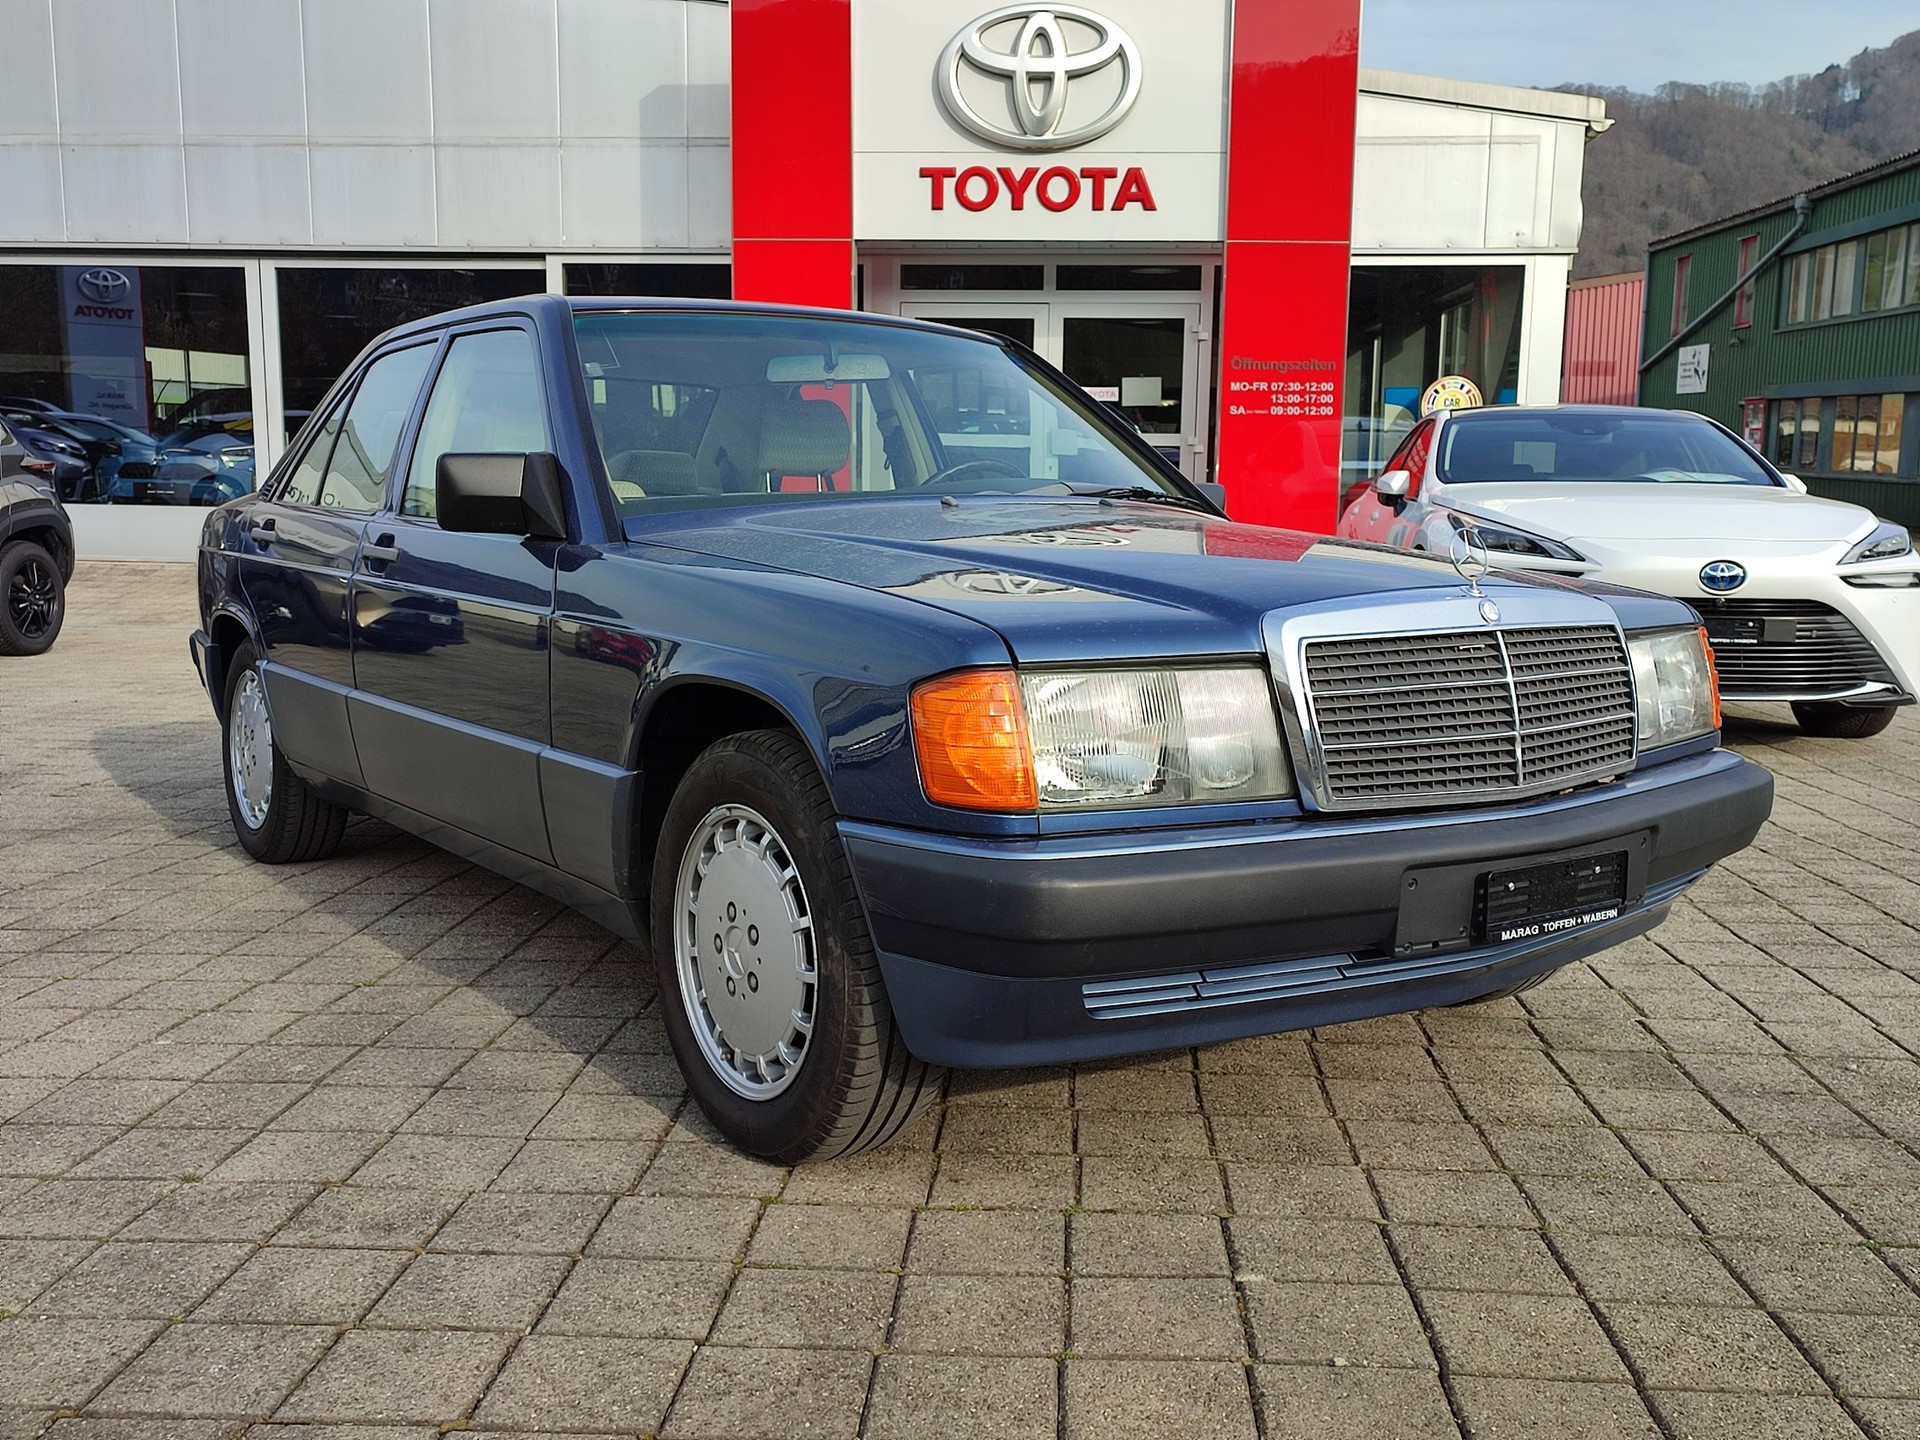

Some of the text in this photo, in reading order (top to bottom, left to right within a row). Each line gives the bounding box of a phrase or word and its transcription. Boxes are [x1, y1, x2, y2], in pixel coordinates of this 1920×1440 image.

[919, 165, 1157, 212] TOYOTA
[1230, 356, 1336, 373] Öffnungszeiten
[1230, 382, 1334, 392] MO-FR 07:30-12:00
[1270, 394, 1333, 404] 13:00-17:00
[1443, 397, 1461, 407] CAR
[1229, 406, 1246, 415] SA
[1270, 406, 1333, 415] 09:00-12:00
[1501, 925, 1539, 941] MARAG
[1543, 917, 1576, 932] TOFFEN
[1582, 908, 1618, 924] WABERN
